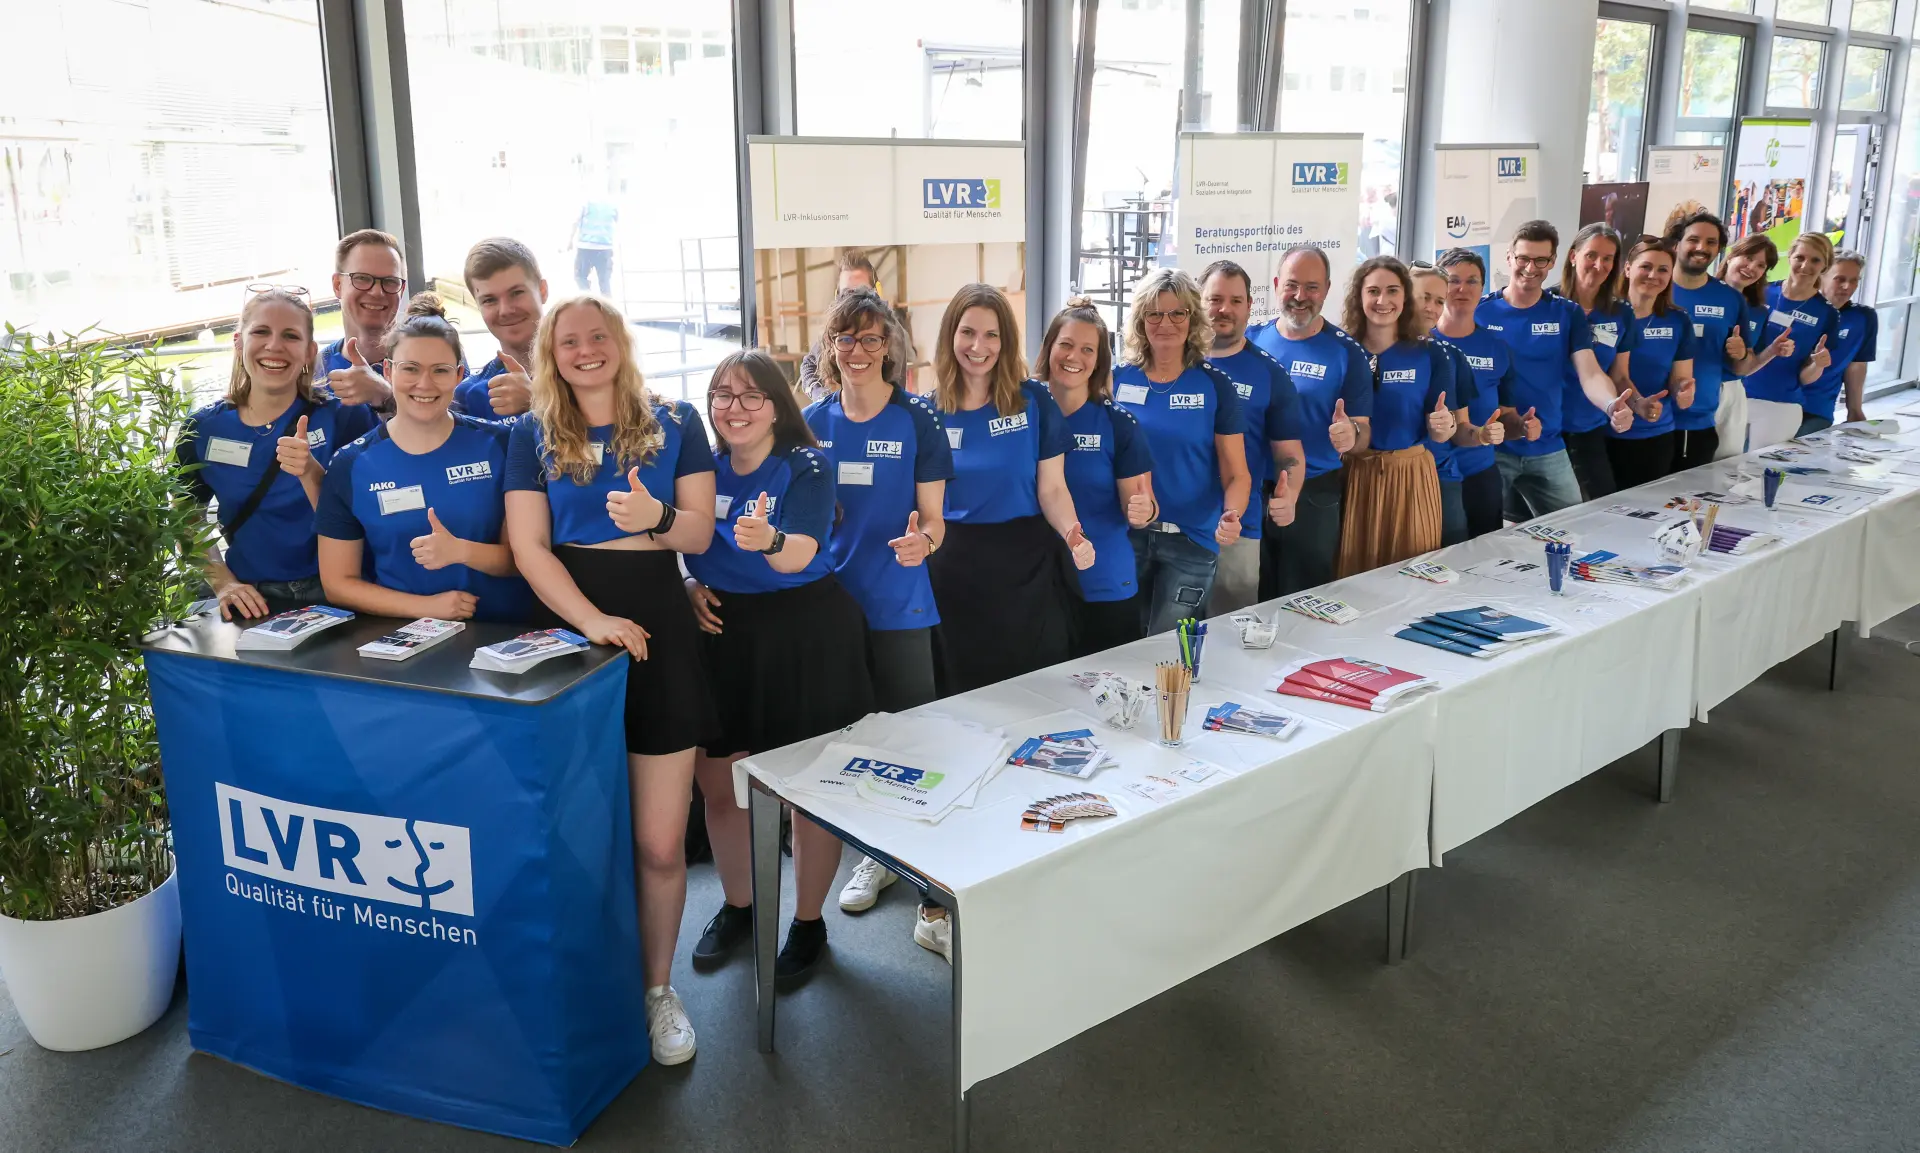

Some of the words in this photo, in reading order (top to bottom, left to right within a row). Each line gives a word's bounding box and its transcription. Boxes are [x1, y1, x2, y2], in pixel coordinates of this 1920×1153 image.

[1499, 159, 1516, 174] LVR
[1294, 165, 1327, 183] LVR
[926, 182, 971, 205] LVR
[1226, 188, 1252, 197] Integration
[1322, 186, 1348, 194] Menschen
[783, 213, 849, 222] LVR-Inklusionsamt
[923, 209, 952, 221] Qualität
[953, 209, 965, 219] für
[966, 209, 1002, 220] Menschen
[1446, 215, 1466, 229] EAA
[1195, 224, 1285, 240] Beratungsportfolio
[1286, 224, 1303, 236] des
[1194, 242, 1253, 255] Technischen
[1696, 306, 1713, 314] LVR
[1793, 311, 1808, 321] LVR
[1533, 324, 1549, 332] LVR
[1469, 357, 1481, 366] VR
[1293, 362, 1312, 373] LVR
[1385, 371, 1403, 380] LVR
[1171, 395, 1191, 405] LVR
[991, 417, 1013, 431] LVR
[869, 442, 889, 452] LVR
[449, 466, 474, 478] LVR
[369, 481, 396, 491] JAKO
[884, 779, 928, 795] Menschen
[228, 797, 368, 886] LVR
[225, 872, 306, 914] Qualität
[312, 895, 346, 922] für
[353, 902, 477, 946] Menschen
